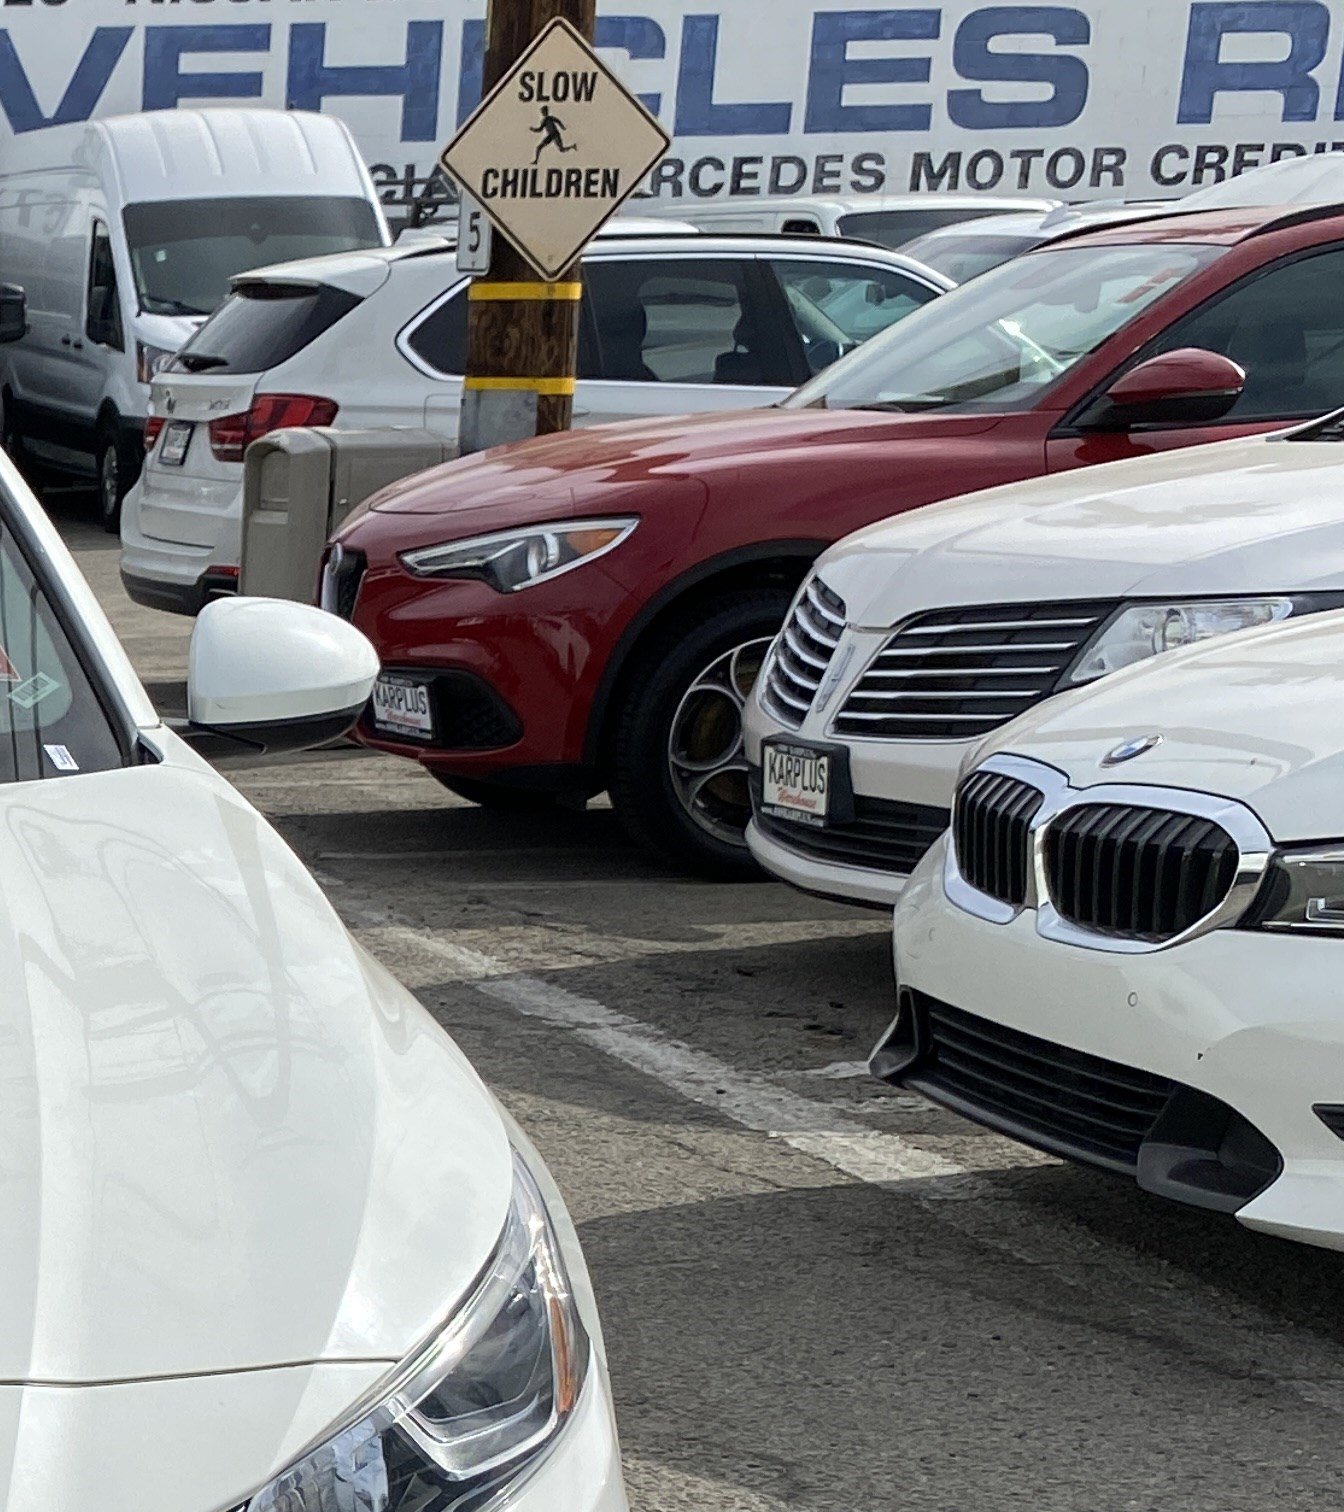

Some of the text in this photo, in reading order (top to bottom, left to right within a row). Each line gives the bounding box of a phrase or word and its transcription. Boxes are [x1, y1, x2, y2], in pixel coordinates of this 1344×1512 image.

[518, 71, 597, 102] SLOW
[482, 167, 619, 199] CHILDREN
[632, 151, 886, 199] RCEDES
[910, 145, 1126, 193] MOTOR
[373, 683, 427, 715] KARPLUS
[768, 752, 826, 794] KARPLUS
